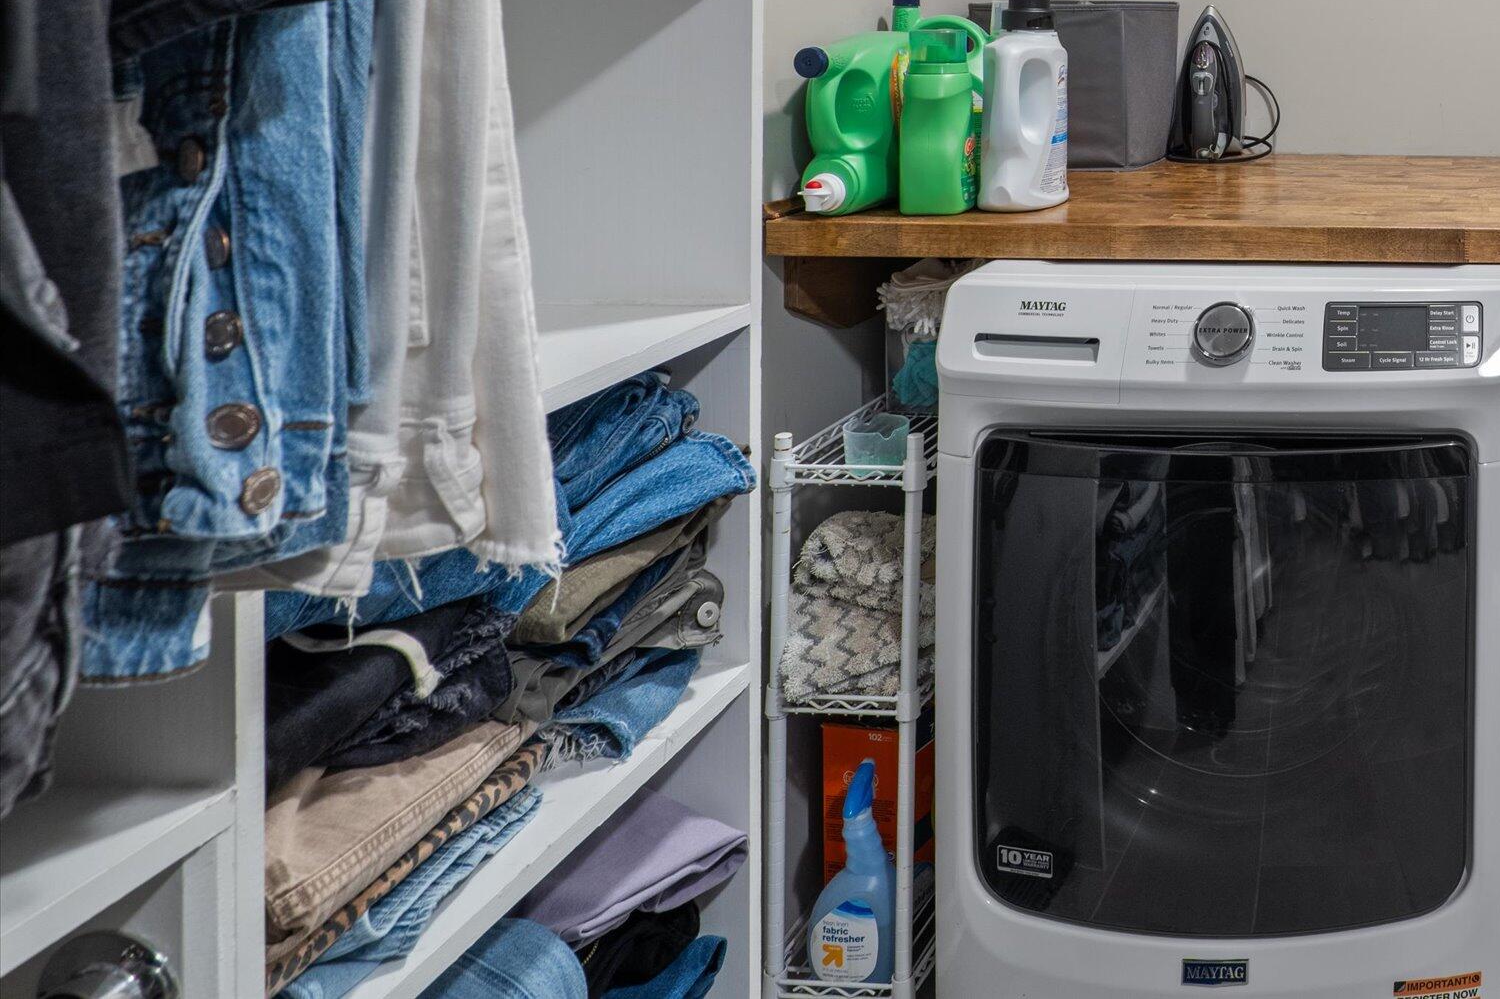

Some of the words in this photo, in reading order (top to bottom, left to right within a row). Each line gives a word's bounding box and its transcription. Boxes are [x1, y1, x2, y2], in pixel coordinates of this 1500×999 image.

[1019, 300, 1067, 311] MAYTAG
[868, 732, 883, 742] 102
[1000, 849, 1023, 865] 10
[1023, 852, 1050, 862] YEAR
[823, 926, 849, 935] fabric
[822, 935, 865, 943] refresher
[1186, 966, 1246, 979] MAYTAG
[1452, 988, 1479, 999] NOW
